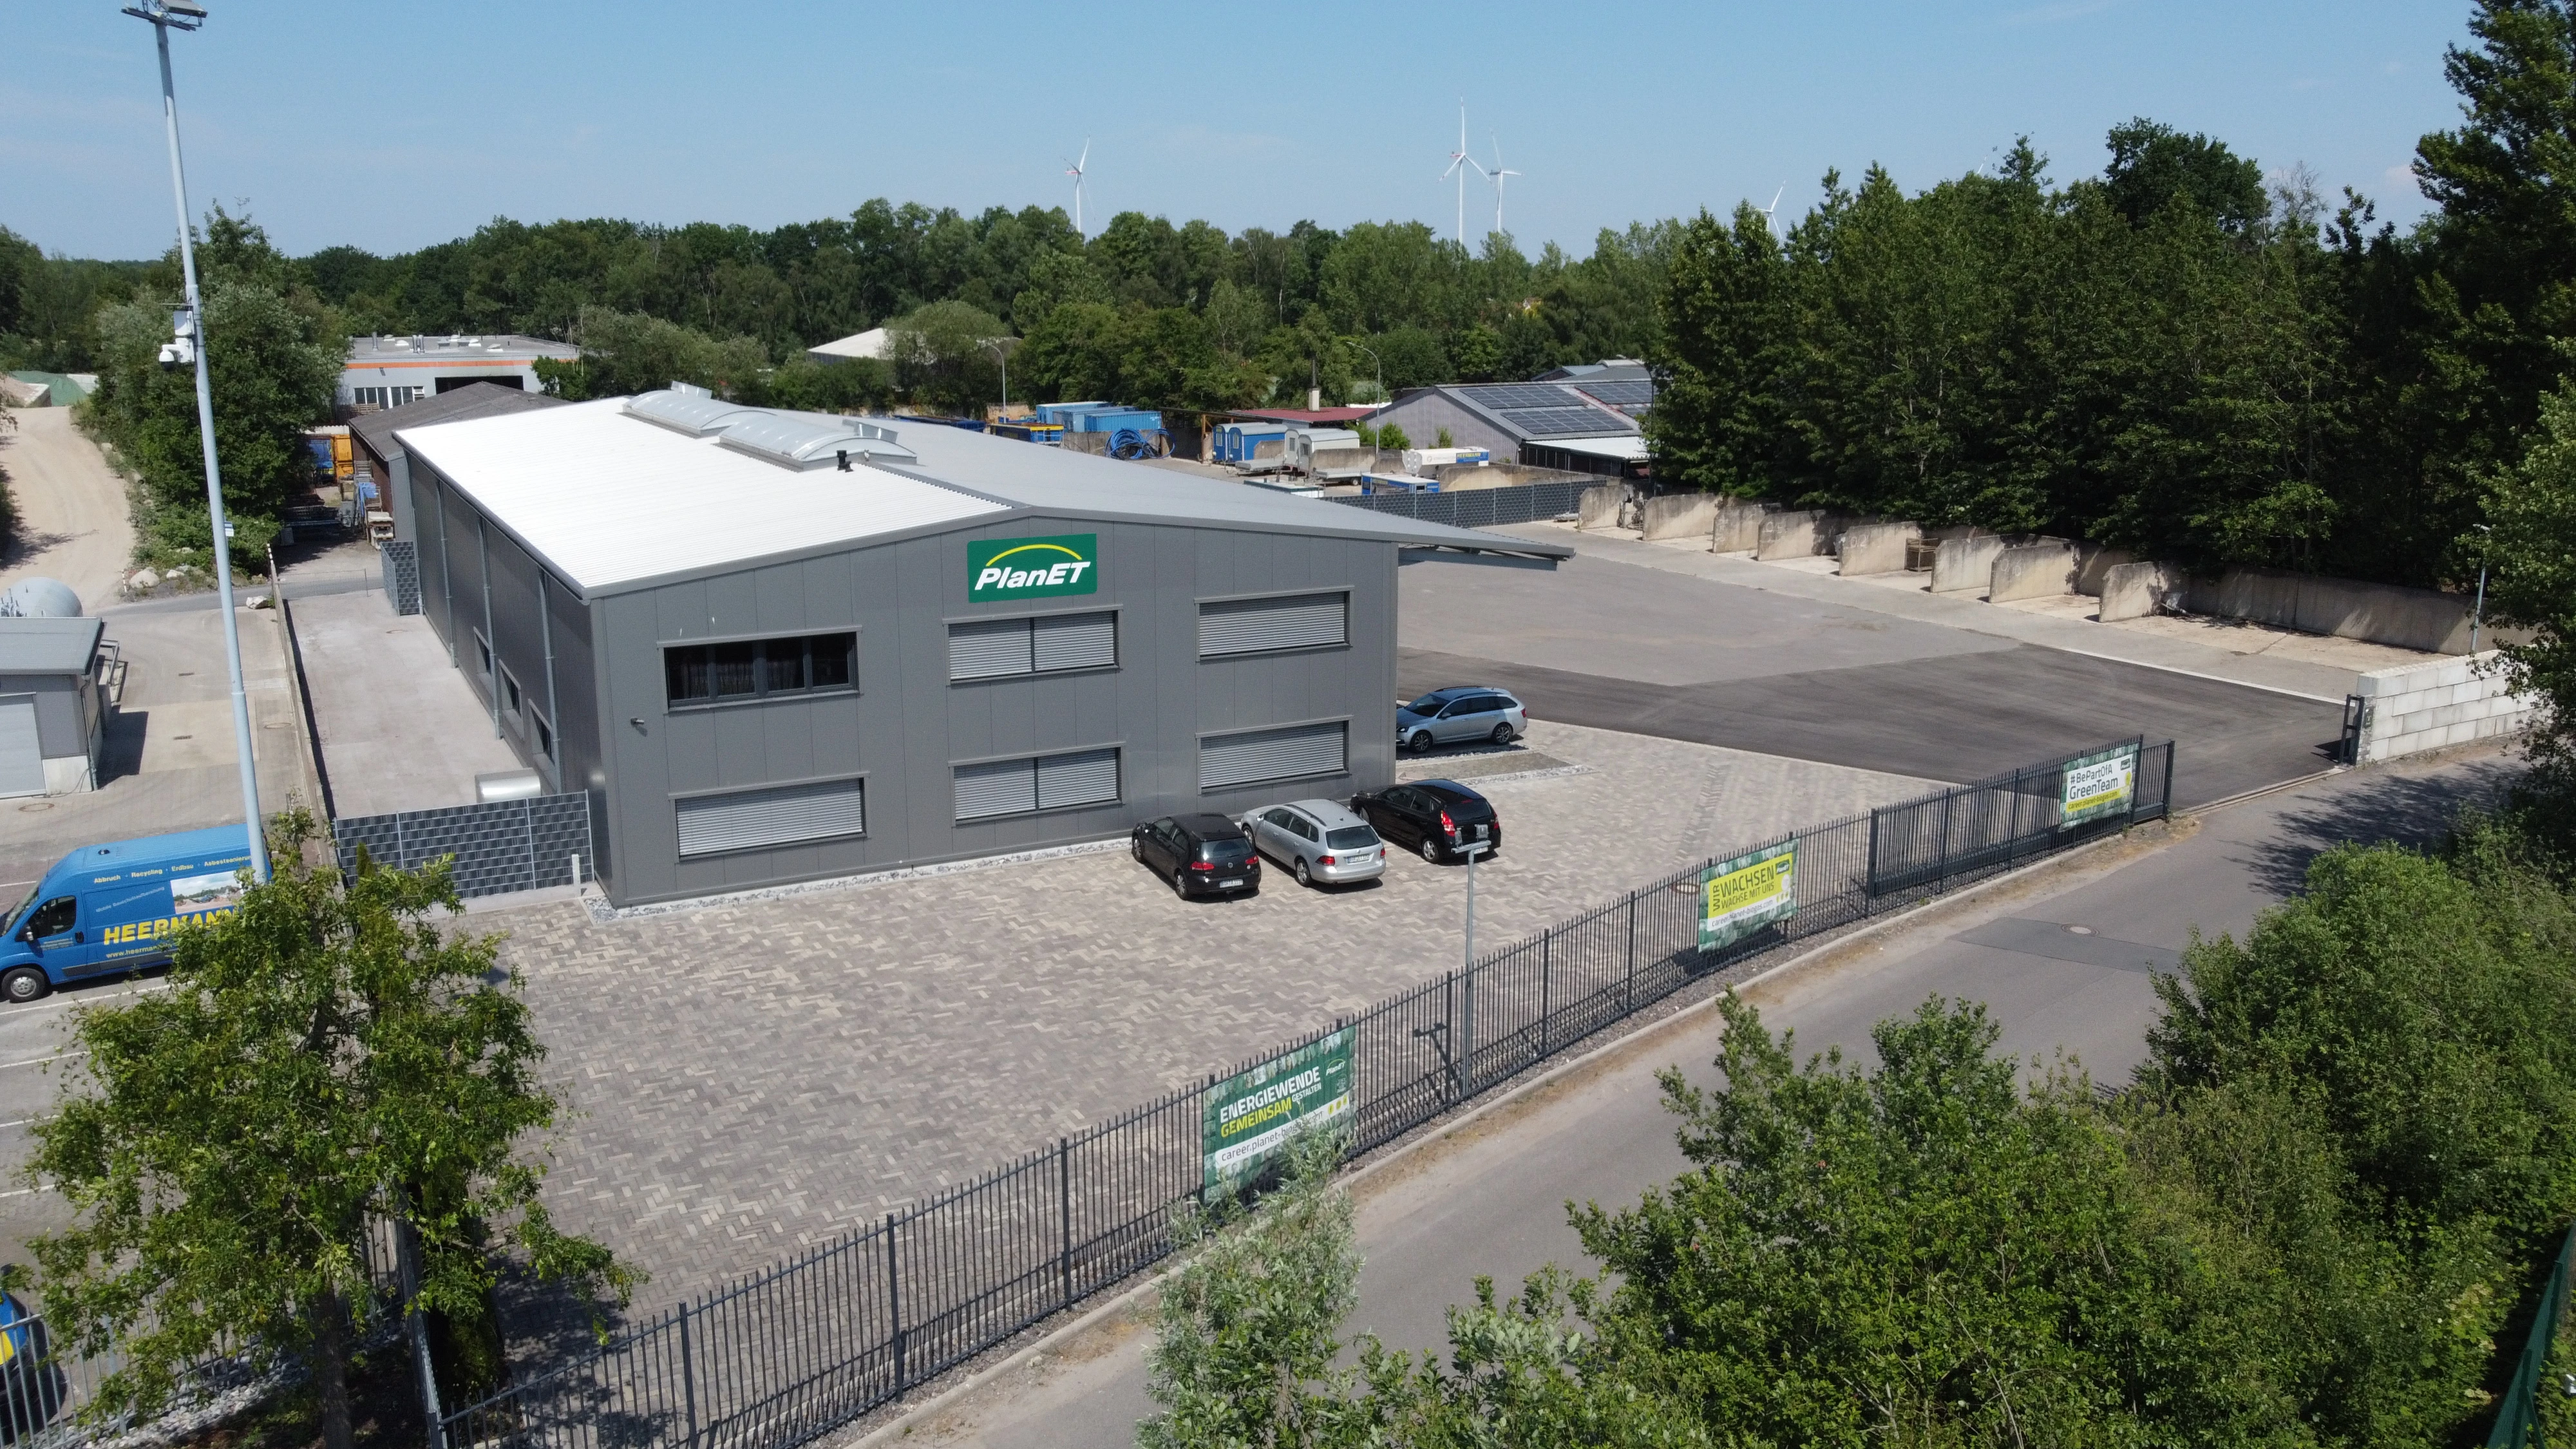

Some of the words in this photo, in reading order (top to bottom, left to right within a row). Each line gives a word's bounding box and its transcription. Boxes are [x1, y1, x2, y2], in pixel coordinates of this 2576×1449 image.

[974, 561, 1092, 591] PlanET
[2070, 764, 2113, 784] #BePartOfA
[2069, 777, 2118, 800] GreenTeam
[94, 875, 121, 884] Abbruch
[131, 869, 163, 878] Recycling
[1720, 865, 1774, 898] WACHSEN
[1721, 892, 1748, 909] WACHSE
[1749, 886, 1761, 898] MIT
[1762, 882, 1774, 893] UNS
[1220, 1066, 1321, 1123] ENERGIEWENDE
[1220, 1097, 1293, 1138] GEMEINSAM
[1292, 1083, 1321, 1103] GESTALTEN
